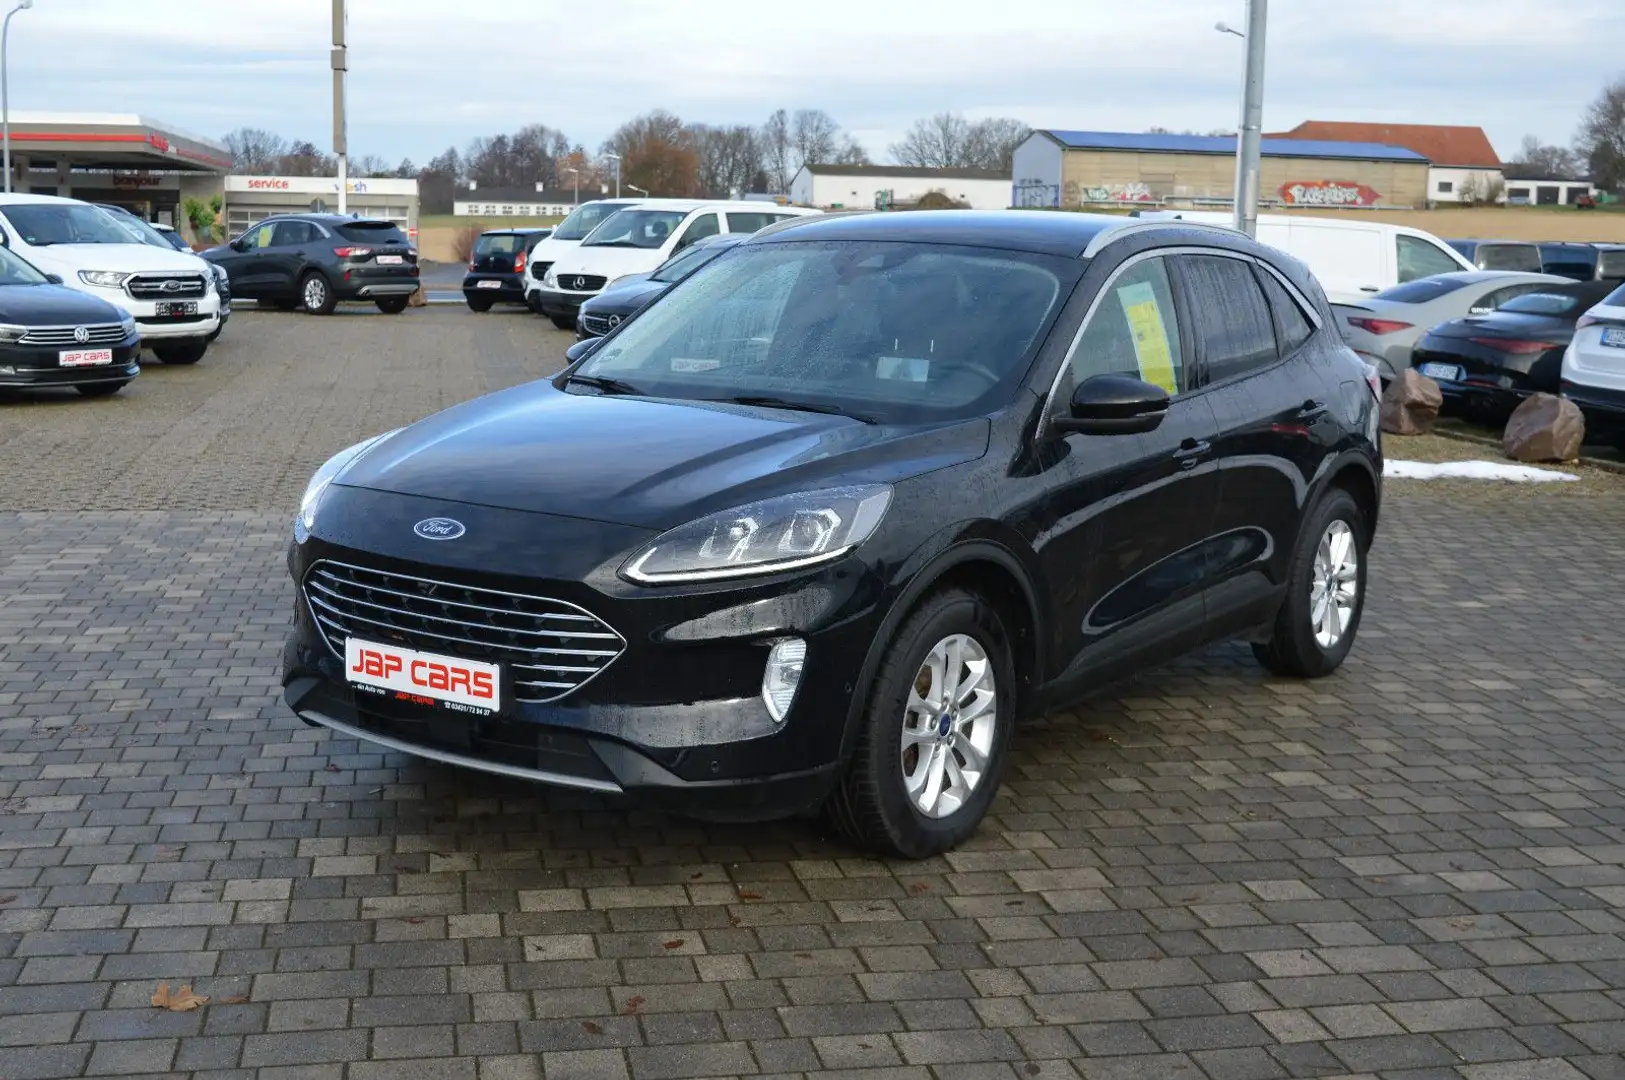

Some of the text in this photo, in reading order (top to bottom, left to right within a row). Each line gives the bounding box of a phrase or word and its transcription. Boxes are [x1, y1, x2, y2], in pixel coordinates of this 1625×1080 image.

[247, 178, 289, 189] service
[423, 520, 453, 534] Ford
[365, 685, 376, 693] Auto
